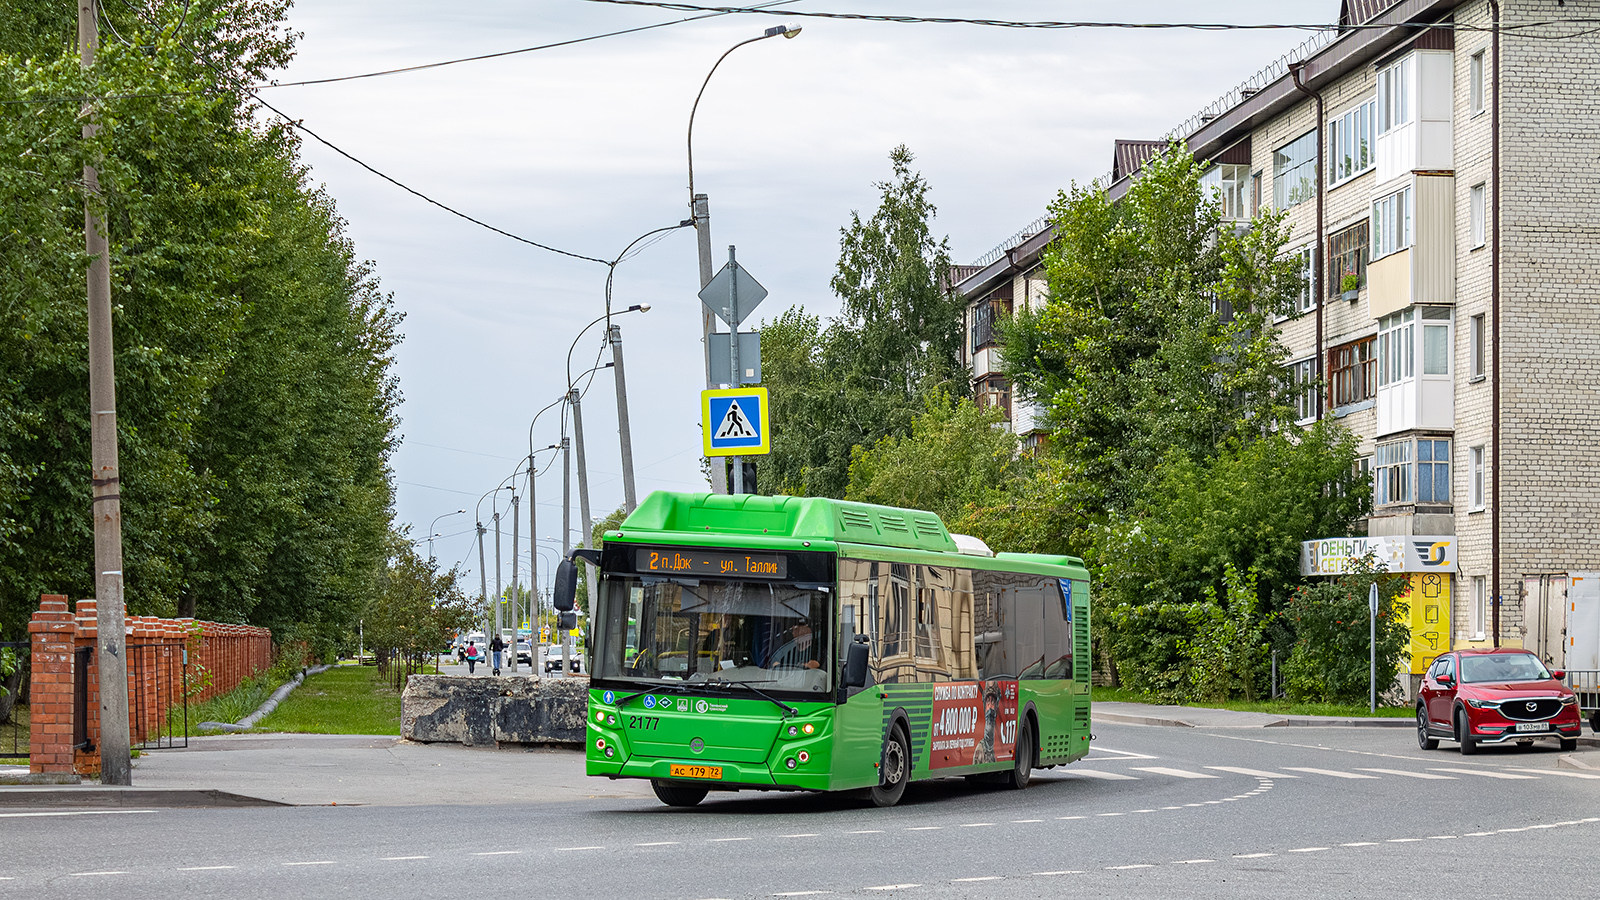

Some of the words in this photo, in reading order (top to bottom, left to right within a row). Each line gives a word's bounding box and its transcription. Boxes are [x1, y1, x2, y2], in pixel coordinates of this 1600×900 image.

[650, 552, 659, 570] 2
[720, 559, 738, 573] ул.
[629, 715, 660, 730] 2177
[940, 708, 944, 736] 4
[946, 708, 958, 736] 800
[958, 706, 971, 734] 000
[1006, 720, 1016, 744] 117
[690, 767, 705, 777] 179
[710, 767, 719, 776] 72
